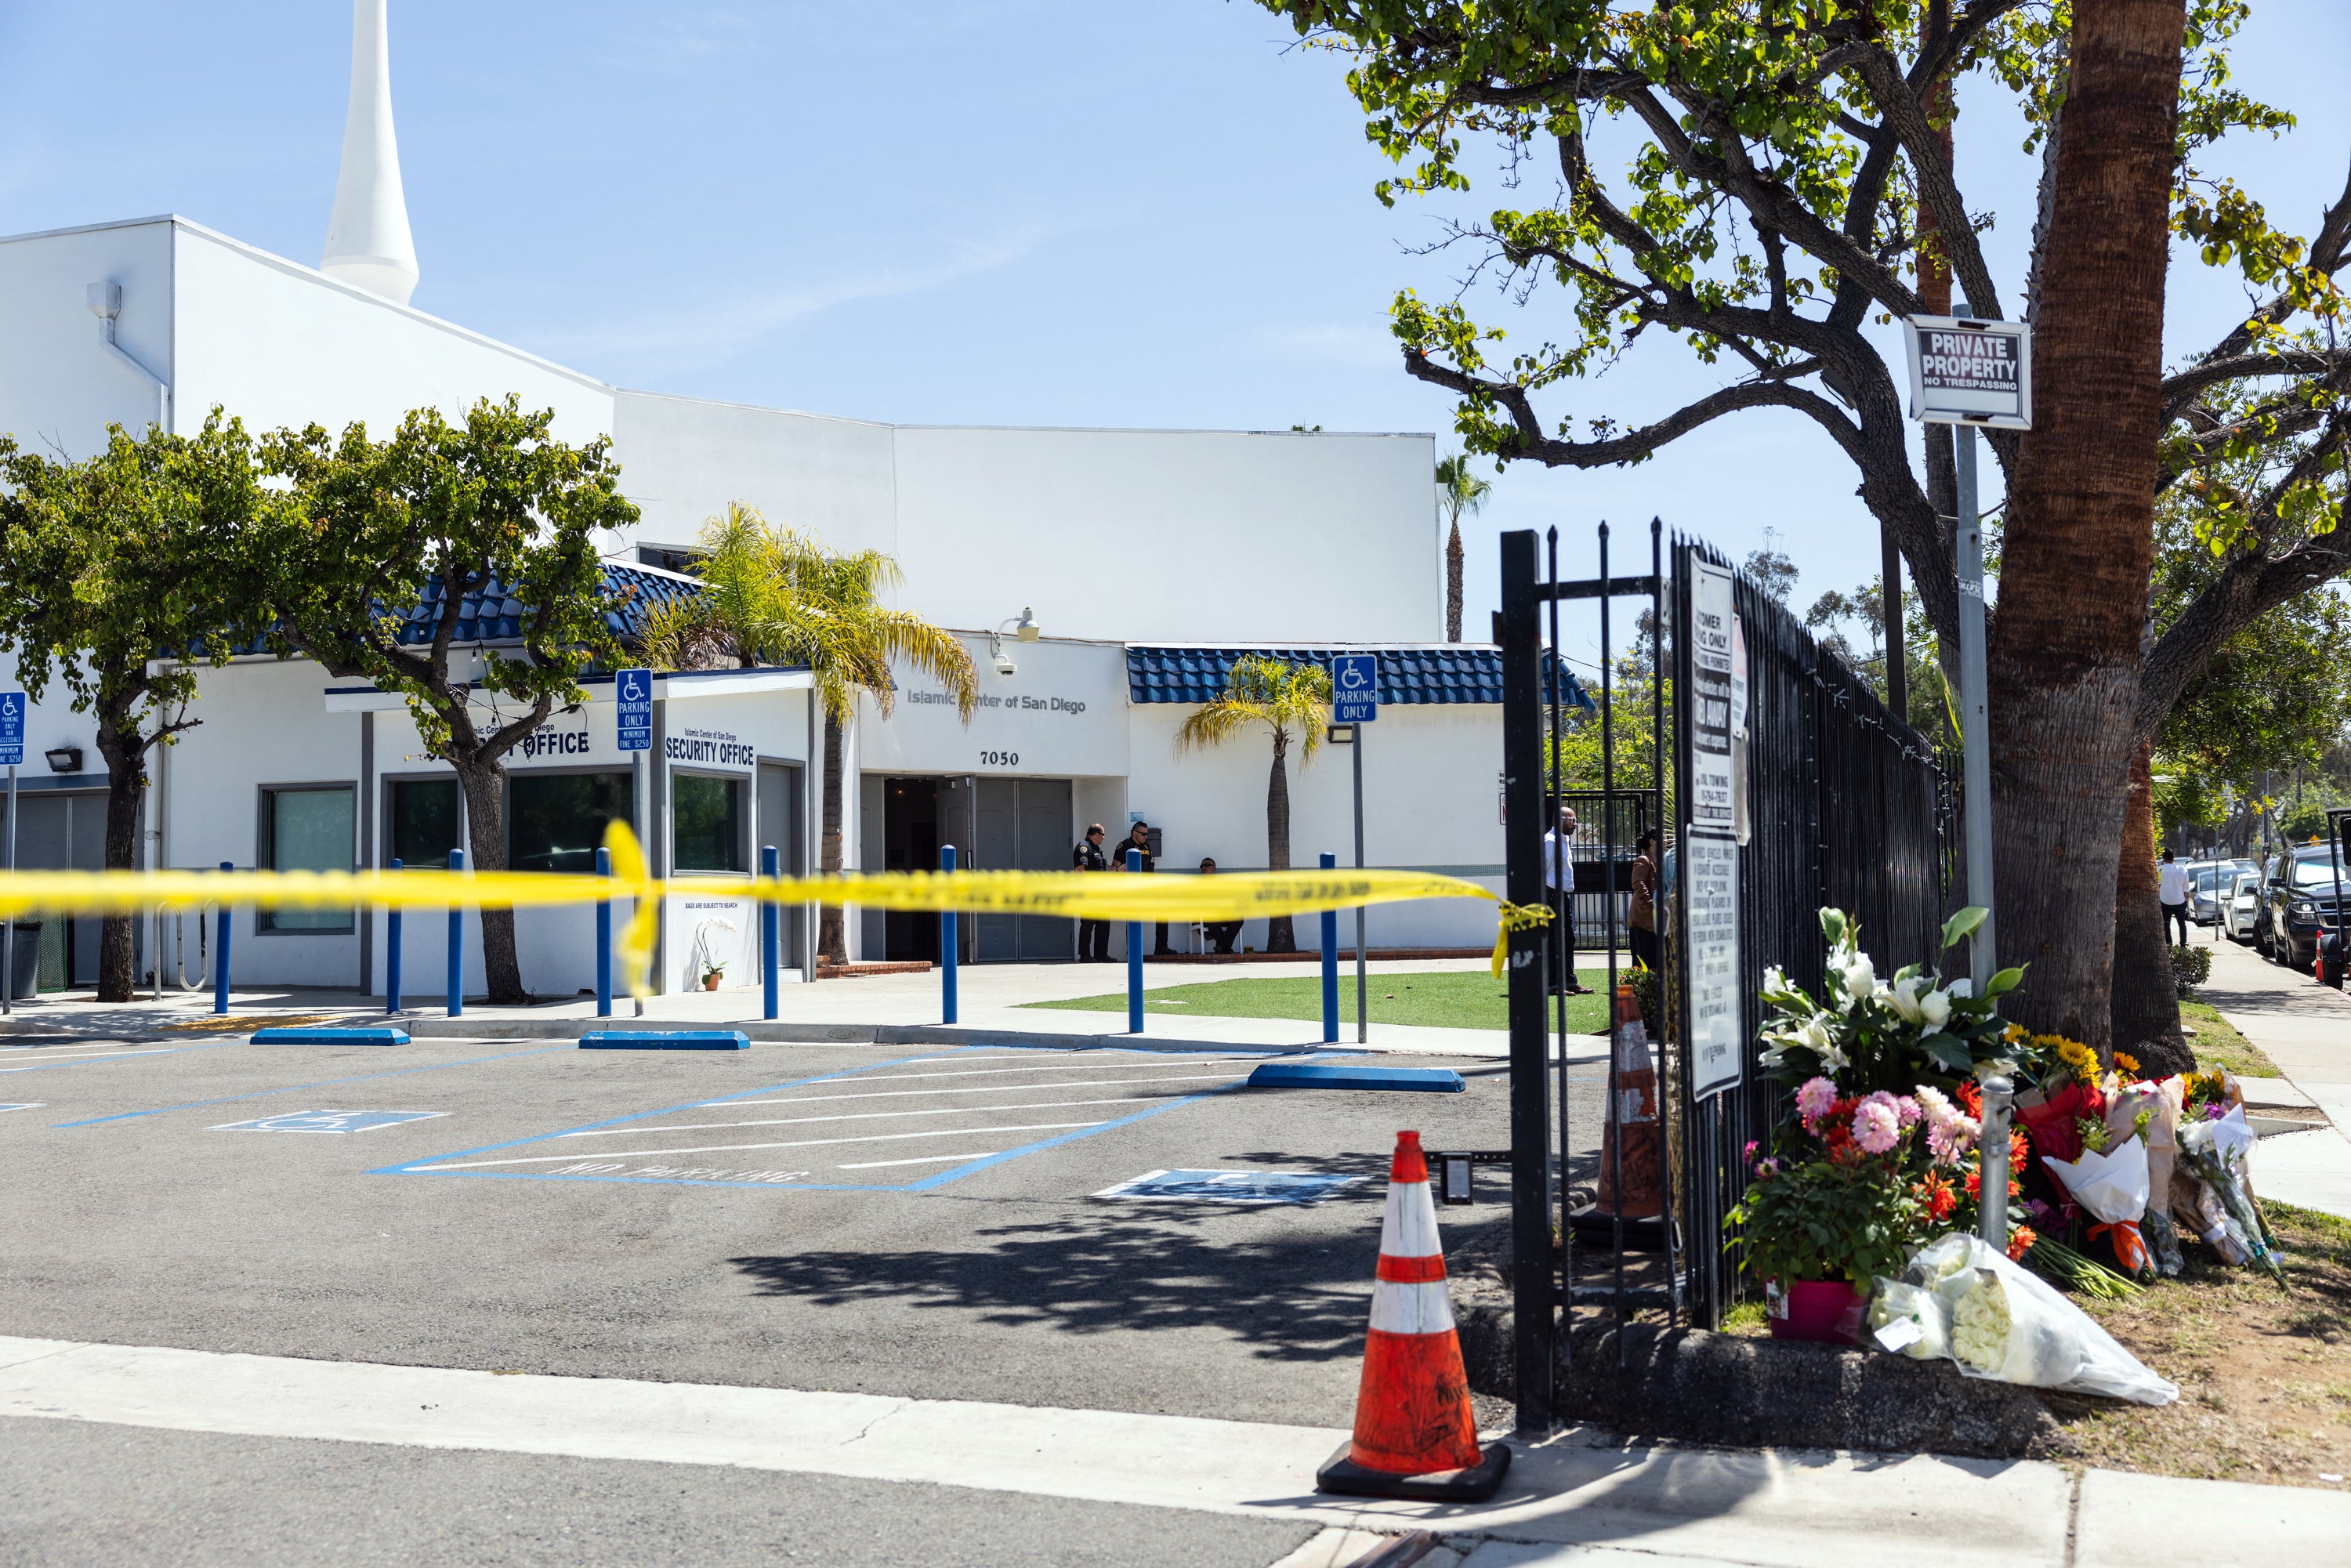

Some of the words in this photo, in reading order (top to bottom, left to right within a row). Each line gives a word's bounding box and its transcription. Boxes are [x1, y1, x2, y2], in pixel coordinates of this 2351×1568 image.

[1931, 333, 2007, 357] PRIVATE
[1922, 354, 2016, 379] PROPERTY
[1943, 378, 2017, 390] TRESPASSING
[1709, 633, 1727, 649] ONLY
[907, 690, 955, 705] Islamic
[1005, 696, 1018, 708] of
[1022, 696, 1047, 710] San
[1051, 697, 1085, 715] Diego
[1335, 690, 1375, 704] PARKING
[619, 701, 650, 713] PARKING
[1343, 705, 1367, 719] ONLY
[625, 715, 643, 726] ONLY
[685, 728, 699, 737] Islamic
[700, 730, 712, 738] Center
[726, 733, 737, 743] Diego
[523, 732, 589, 757] OFFICE
[635, 739, 649, 748] $250
[666, 737, 716, 762] SECURITY
[720, 742, 754, 766] OFFICE
[980, 751, 1019, 766] 7050
[545, 1163, 625, 1175] NO
